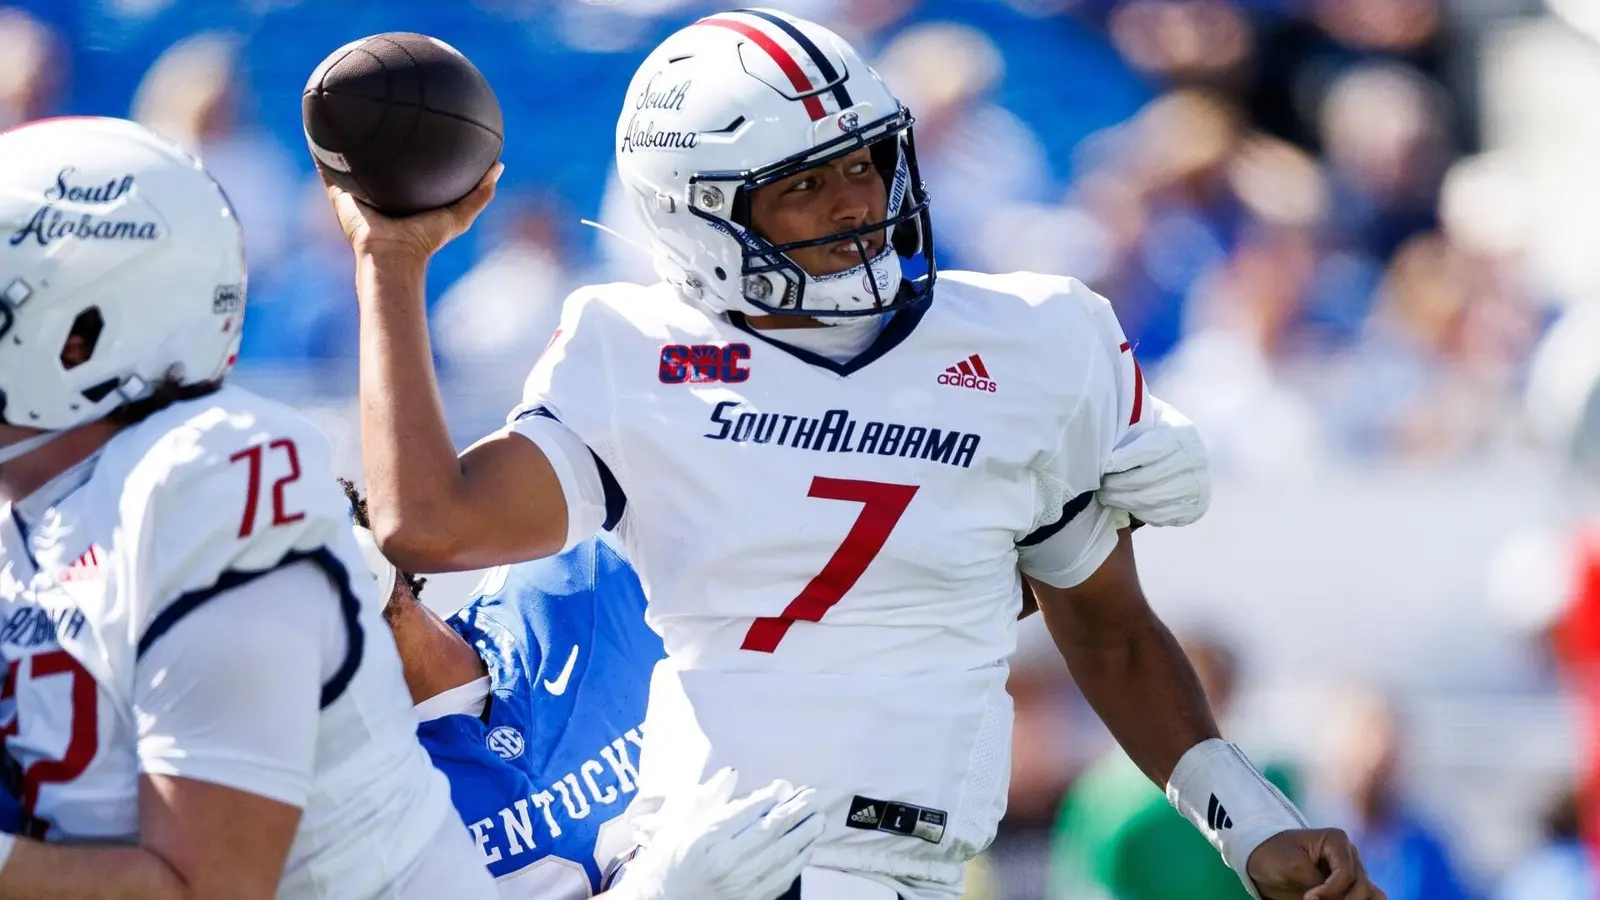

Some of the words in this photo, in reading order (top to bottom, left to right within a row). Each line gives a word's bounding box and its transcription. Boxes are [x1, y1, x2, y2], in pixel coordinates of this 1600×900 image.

[636, 70, 692, 112] South
[621, 113, 700, 154] Alabama
[45, 165, 136, 202] South
[9, 205, 158, 247] Alabama
[936, 372, 998, 394] adidas
[229, 437, 306, 540] 72
[739, 475, 921, 654] 7
[488, 727, 524, 760] SEC
[894, 815, 903, 829] L
